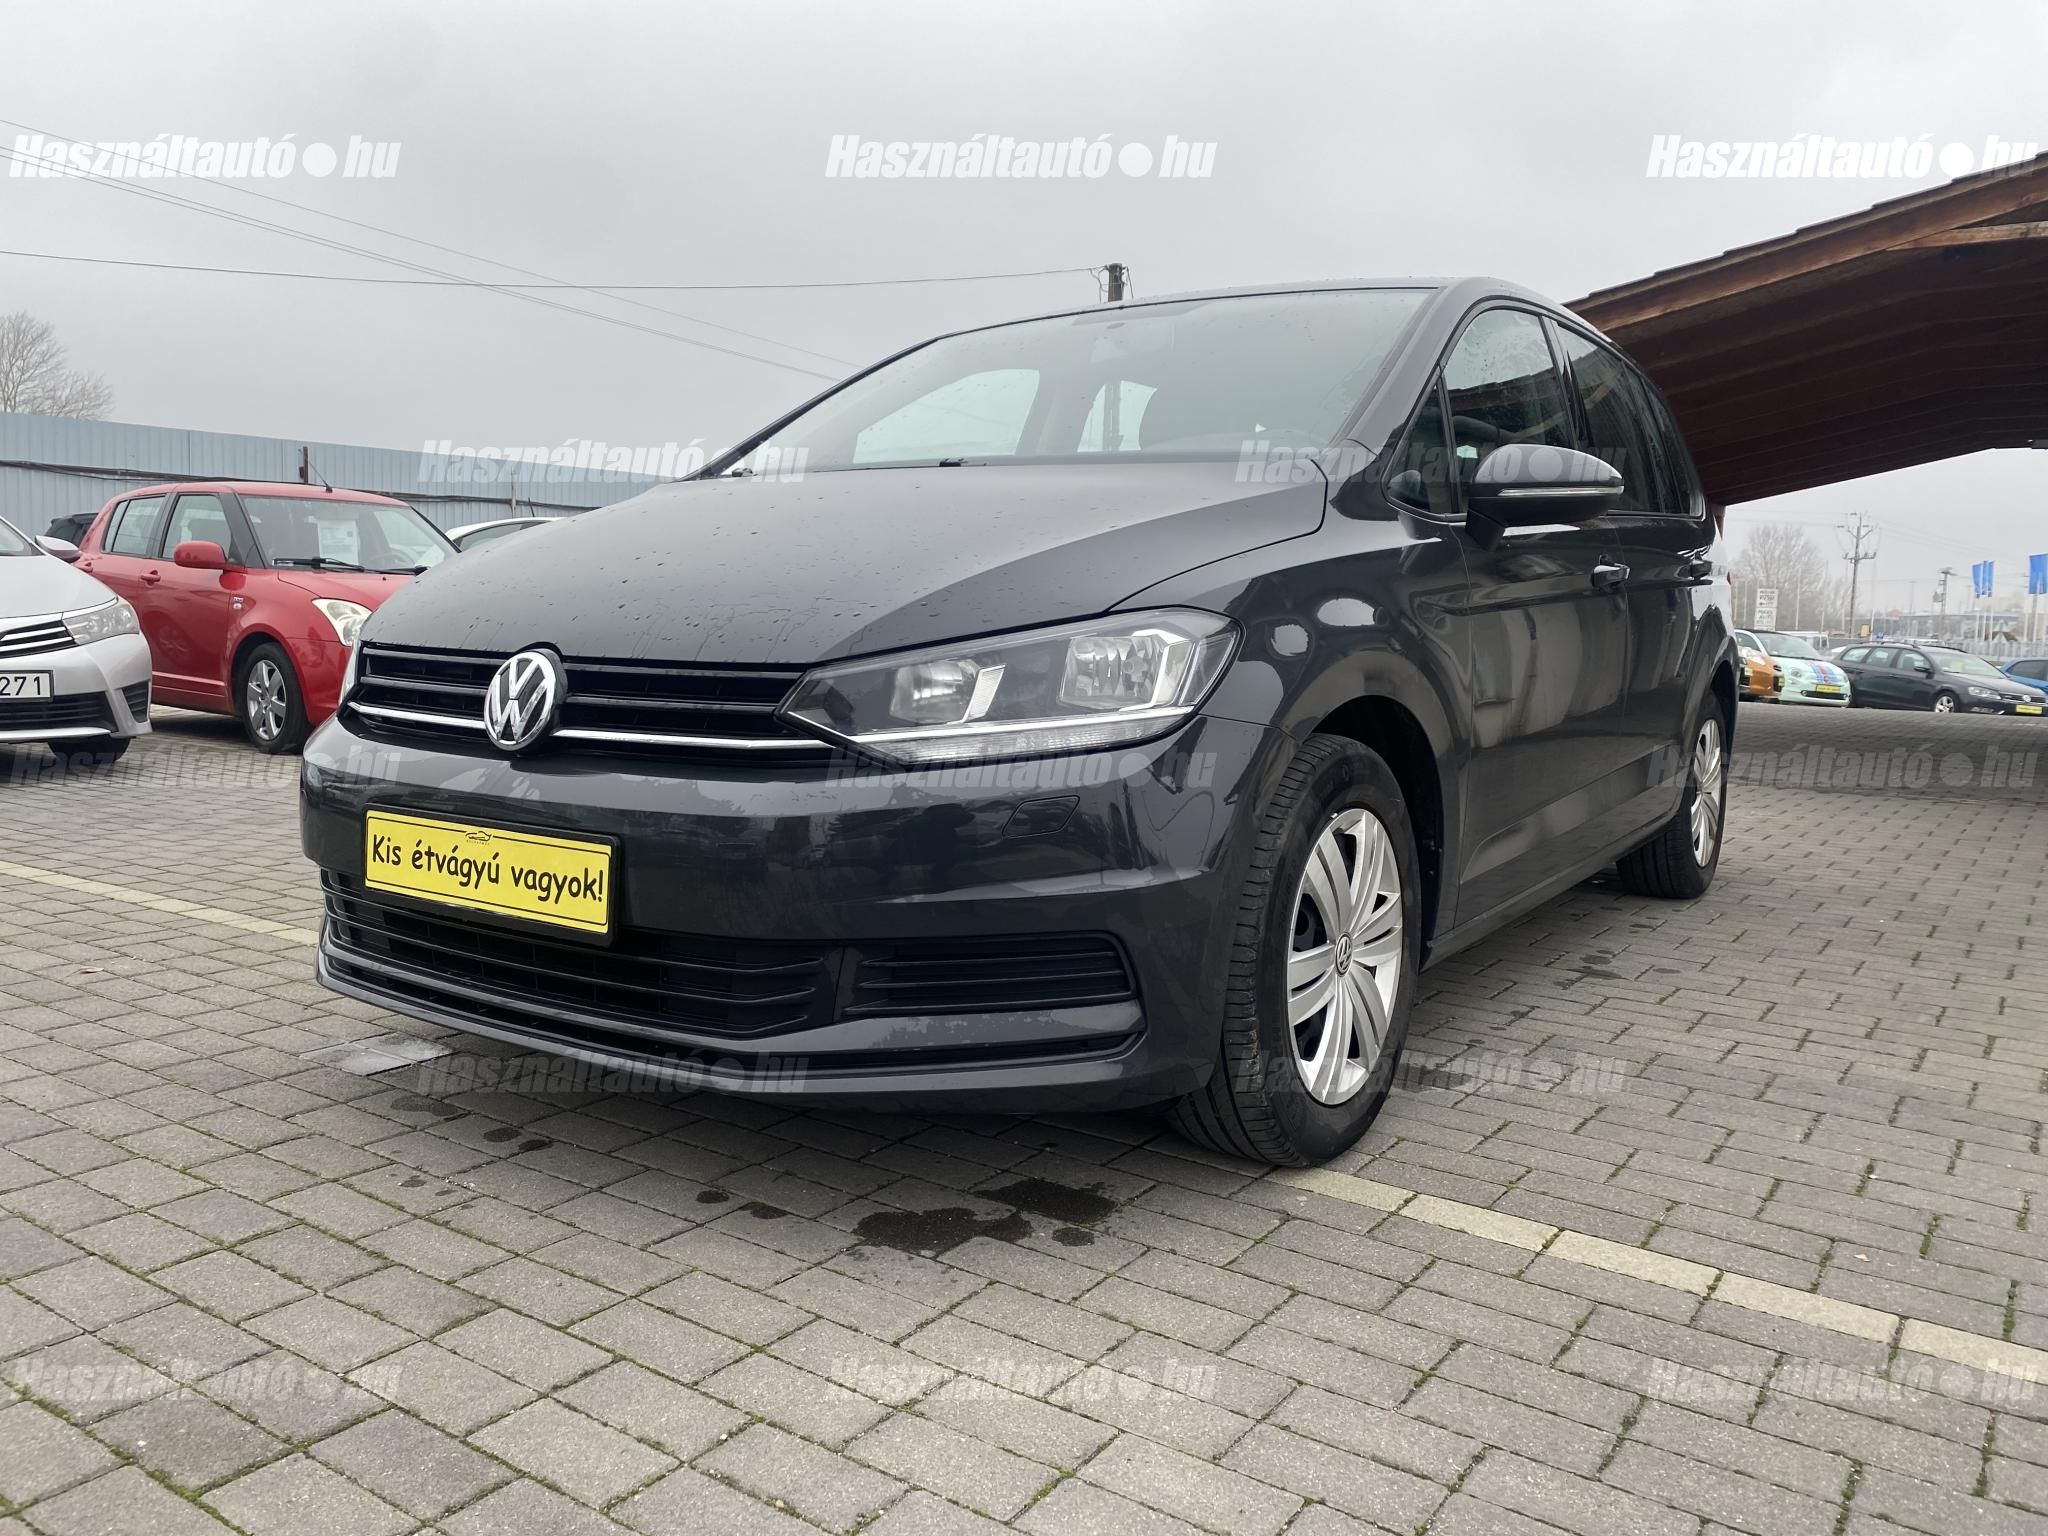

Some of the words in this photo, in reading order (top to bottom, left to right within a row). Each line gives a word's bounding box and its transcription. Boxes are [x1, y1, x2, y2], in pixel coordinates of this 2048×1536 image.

[0, 676, 41, 696] 271
[372, 834, 401, 865] Kis
[411, 840, 500, 889] étvágyú
[511, 864, 604, 903] vagyok!
